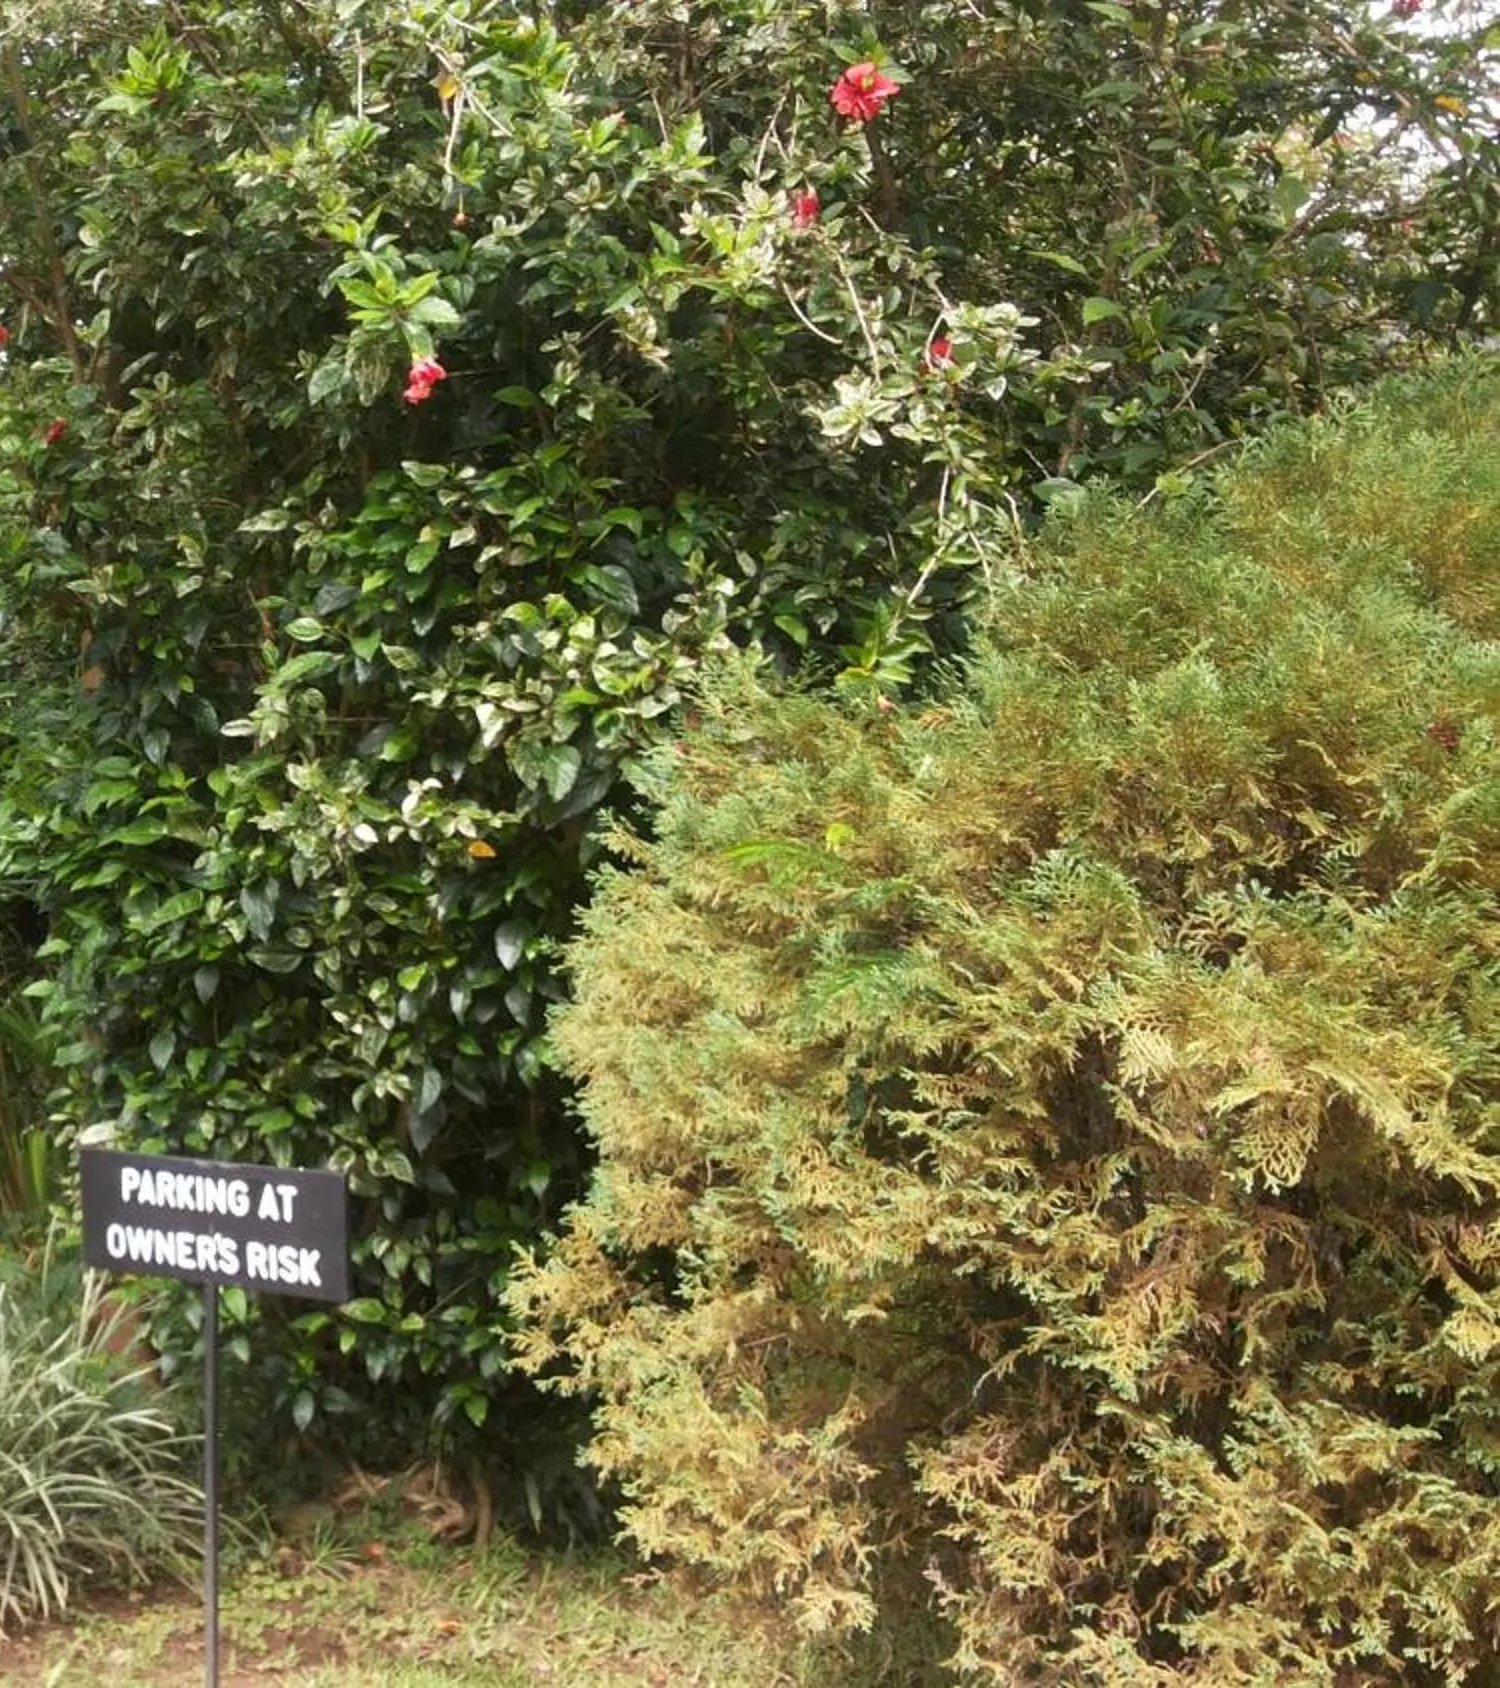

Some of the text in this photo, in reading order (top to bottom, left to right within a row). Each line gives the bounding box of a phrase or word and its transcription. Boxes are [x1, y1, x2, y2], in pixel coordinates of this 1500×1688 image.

[120, 1167, 298, 1223] PARKING AT
[106, 1223, 322, 1287] OWNER'S RISK
